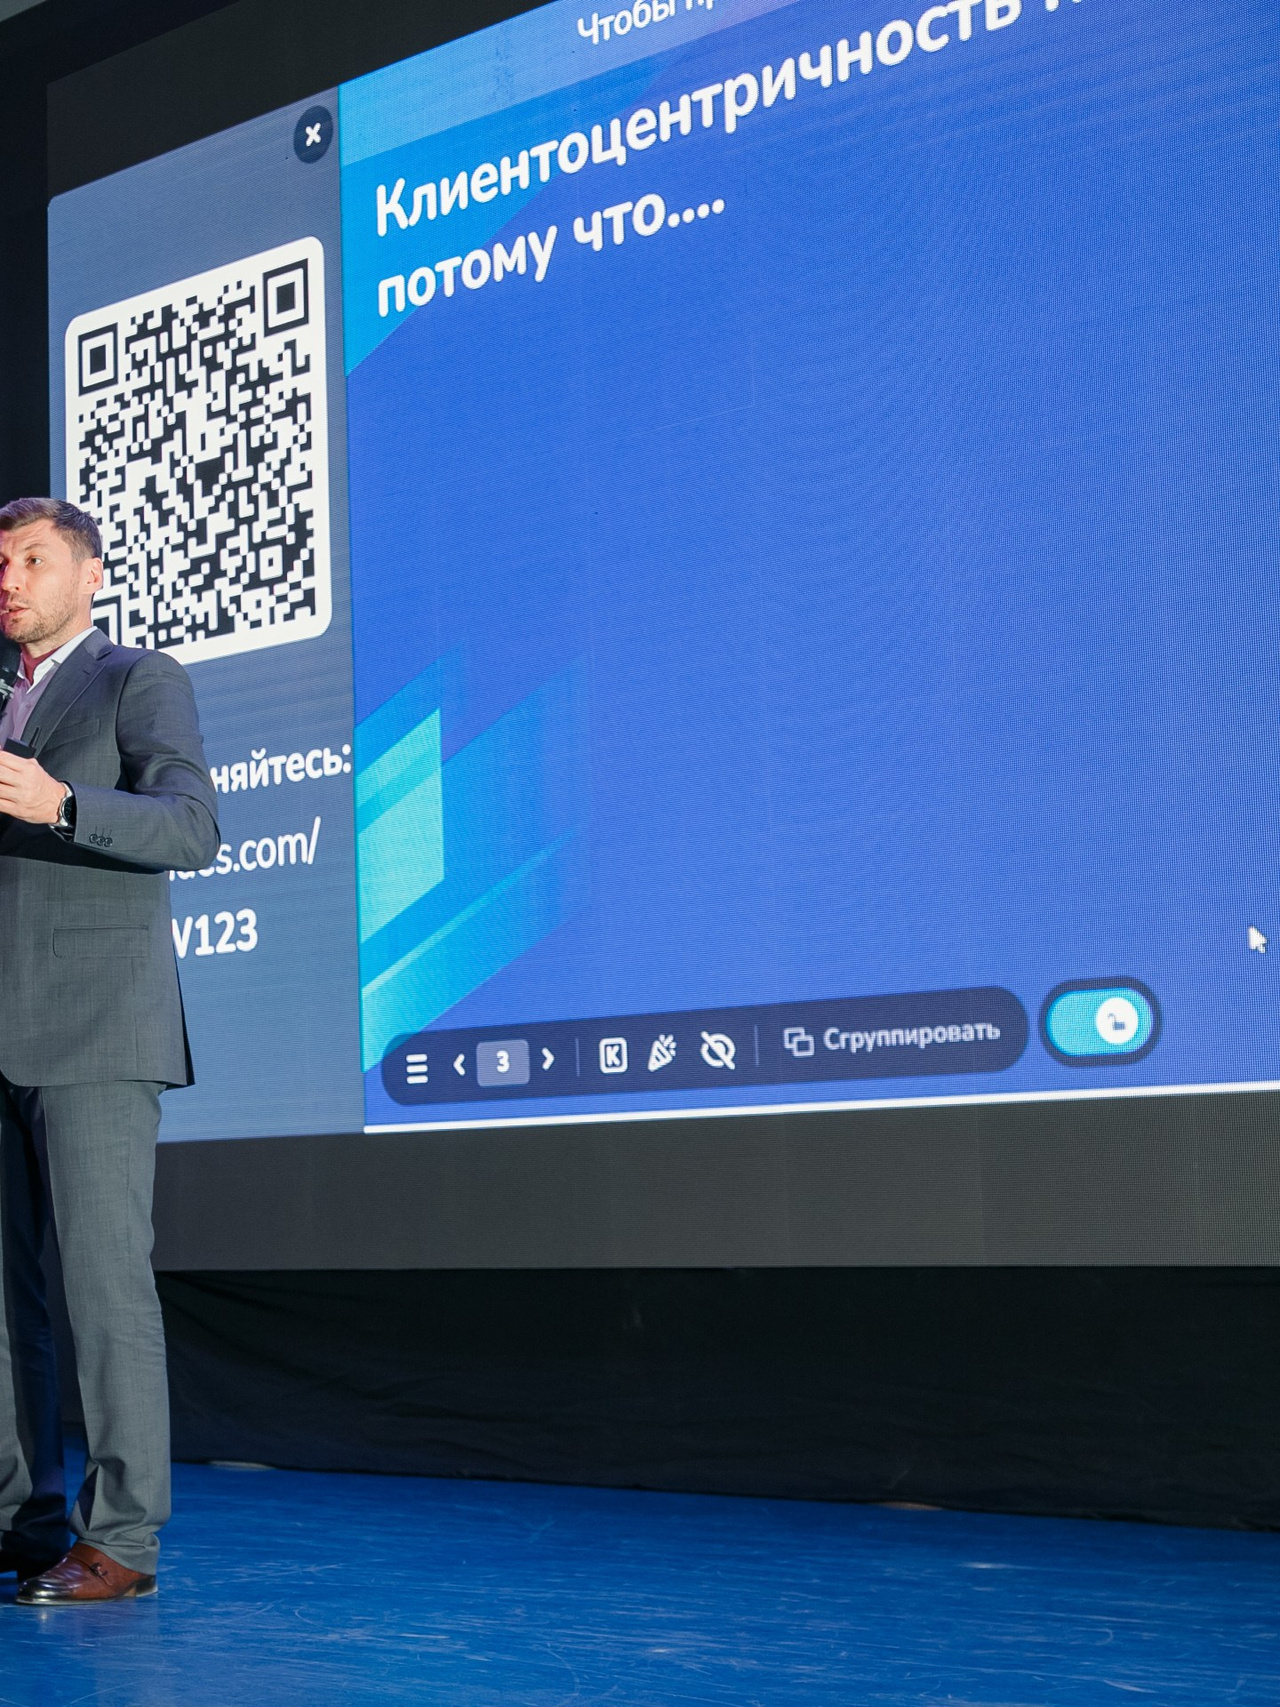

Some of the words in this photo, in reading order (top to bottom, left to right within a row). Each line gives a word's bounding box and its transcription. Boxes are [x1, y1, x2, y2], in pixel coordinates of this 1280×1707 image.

[577, 0, 676, 45] Чтобы
[376, 0, 1021, 237] Клиентоцентричность
[378, 225, 558, 317] потому
[573, 193, 725, 251] что....
[823, 1022, 1001, 1053] Сгруппировать
[496, 1050, 510, 1073] 3
